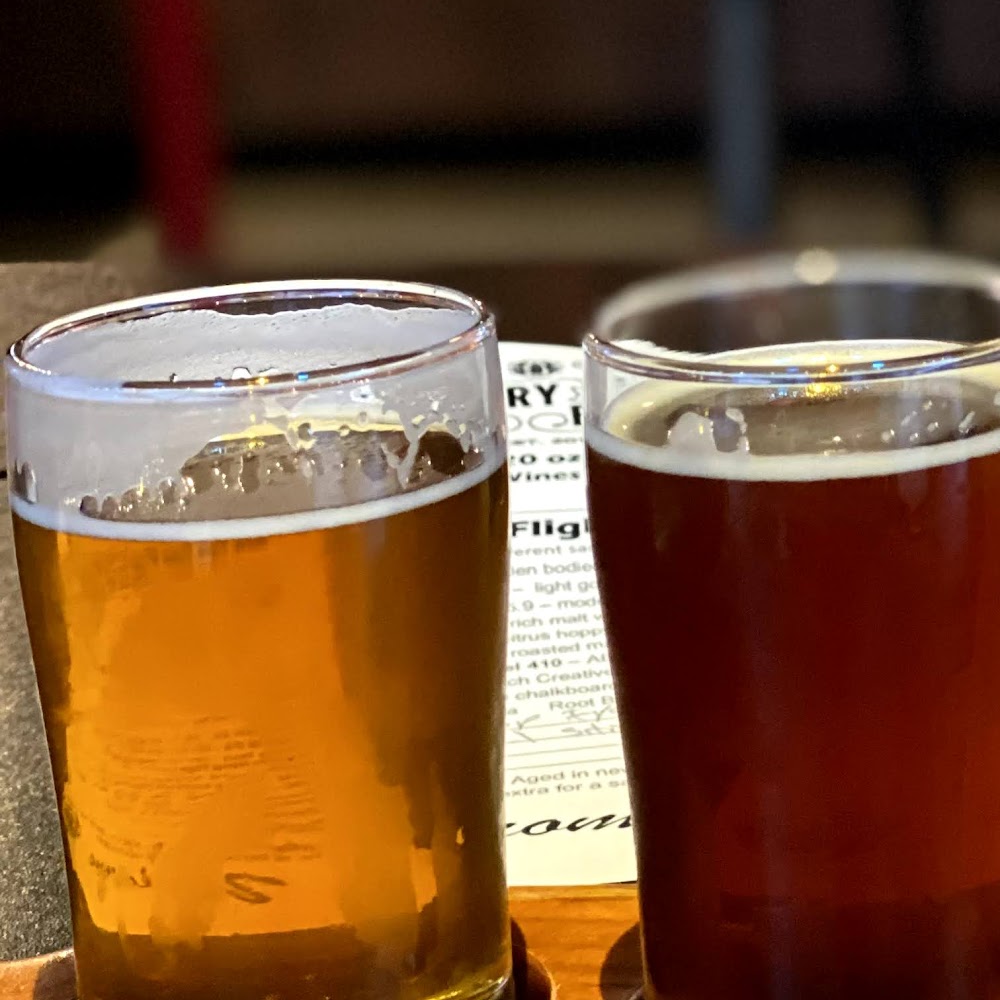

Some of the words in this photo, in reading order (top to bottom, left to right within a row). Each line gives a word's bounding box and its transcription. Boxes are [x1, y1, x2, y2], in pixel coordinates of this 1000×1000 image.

[507, 384, 556, 407] RY
[511, 643, 581, 658] roasted
[549, 698, 595, 712] Root
[511, 771, 565, 785] Aged
[571, 769, 588, 779] in
[556, 783, 582, 792] for
[589, 781, 602, 790] a
